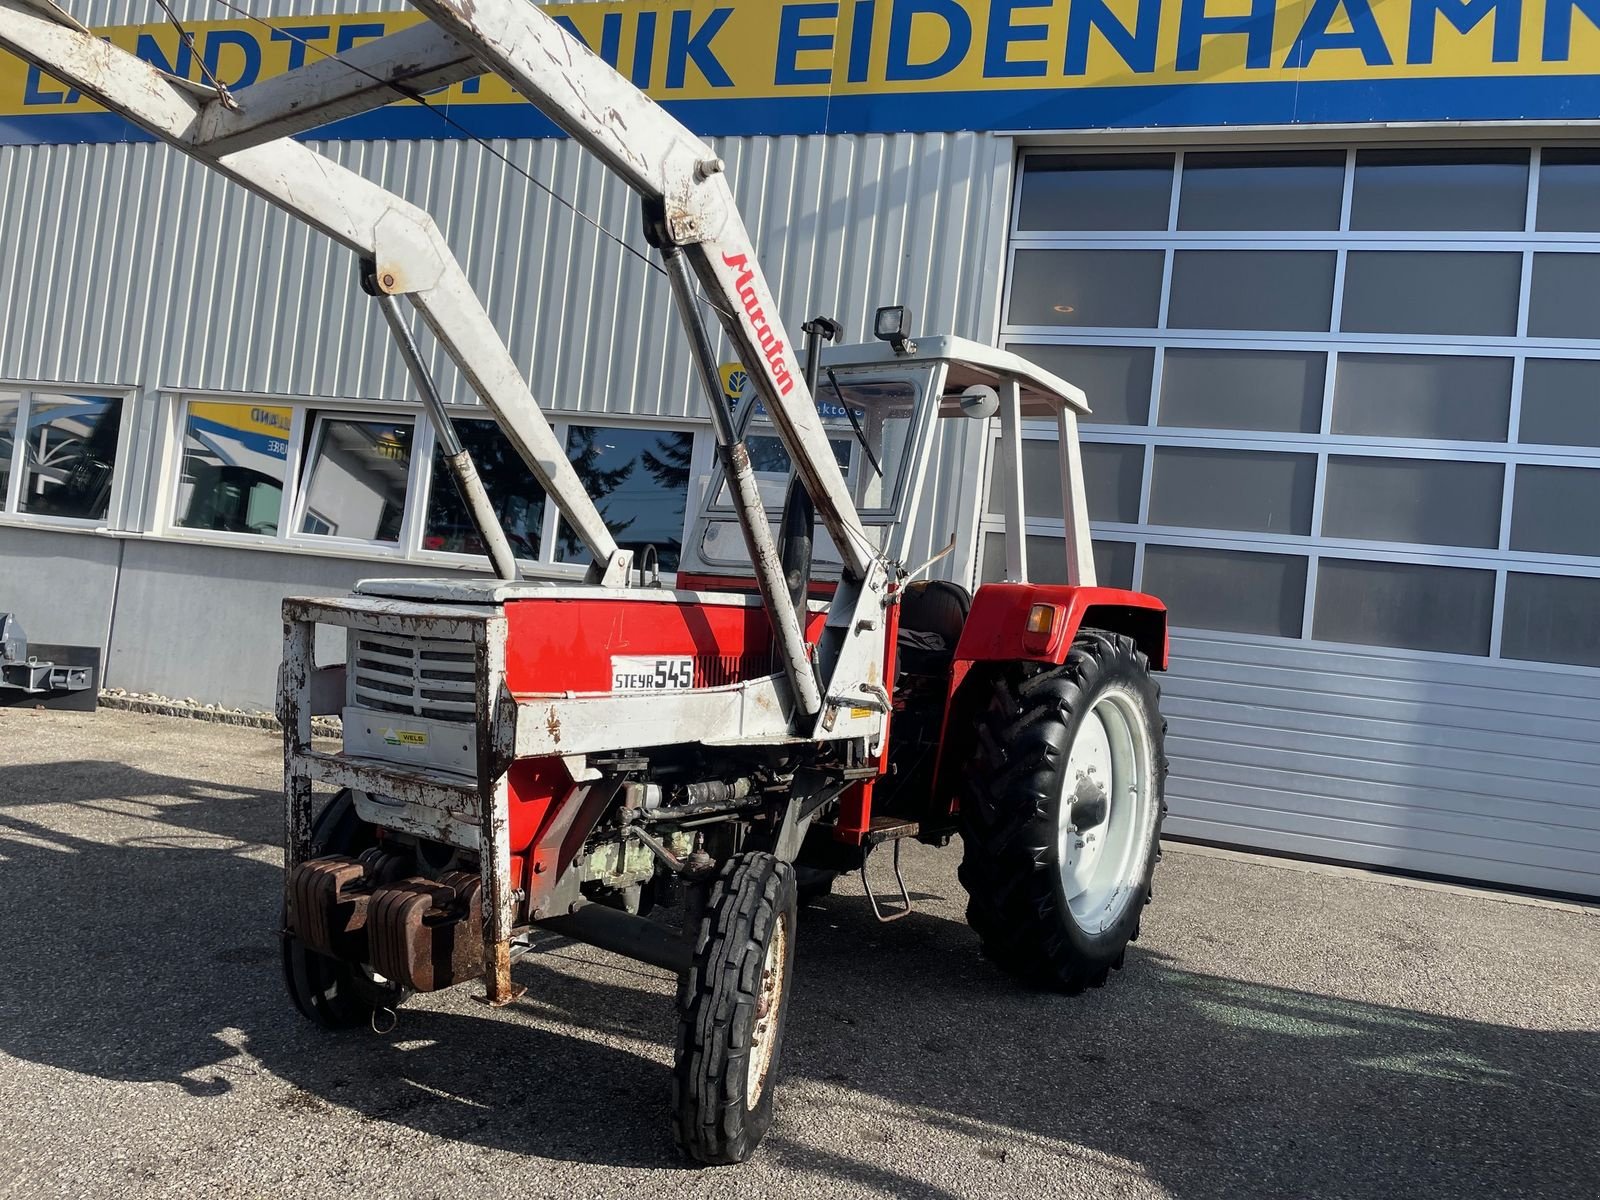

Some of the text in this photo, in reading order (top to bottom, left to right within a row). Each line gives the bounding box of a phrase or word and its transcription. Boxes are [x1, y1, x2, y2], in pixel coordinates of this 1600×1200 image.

[722, 251, 794, 396] Maraton
[614, 660, 692, 689] STEYR 545
